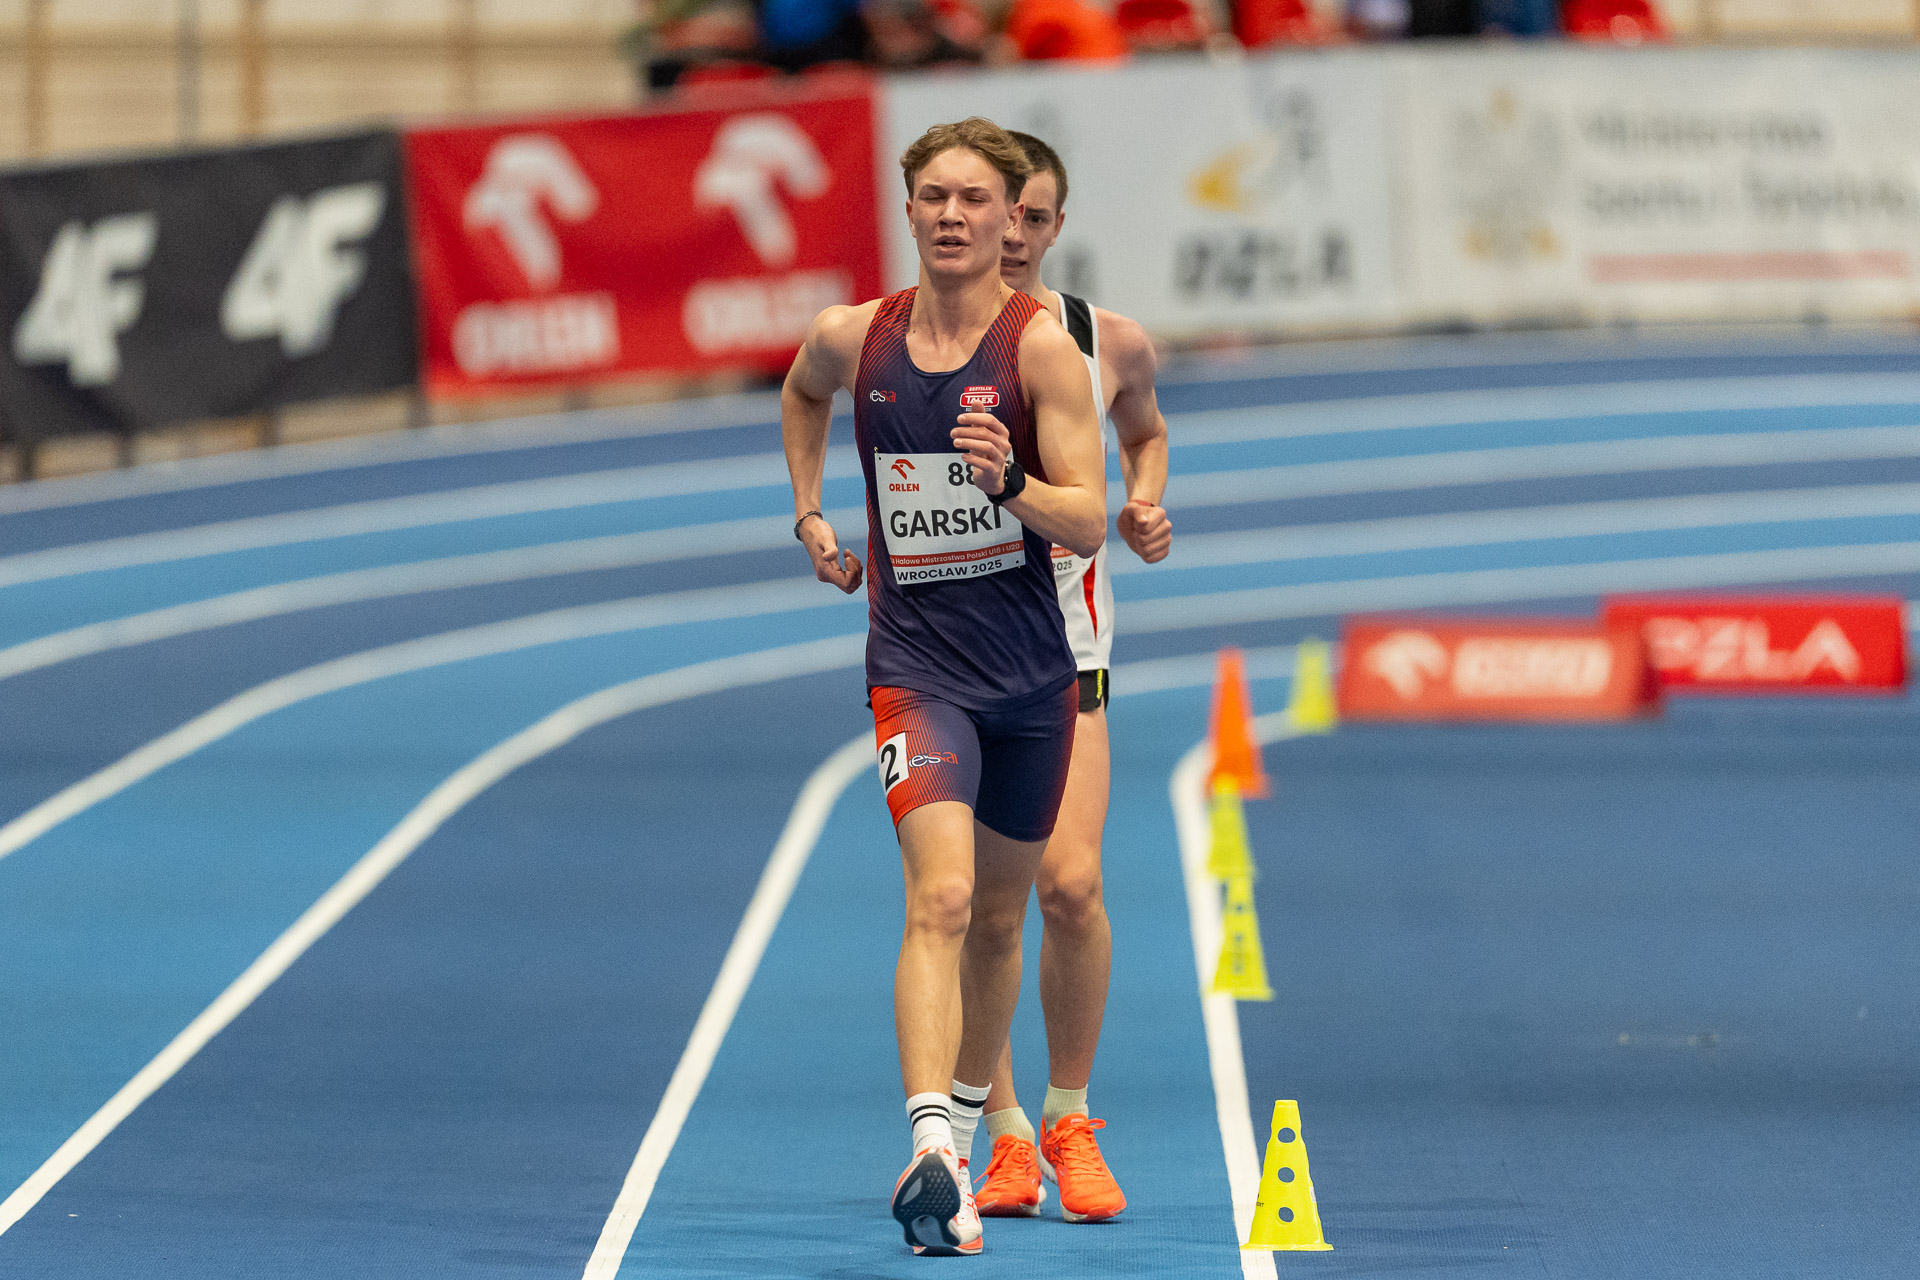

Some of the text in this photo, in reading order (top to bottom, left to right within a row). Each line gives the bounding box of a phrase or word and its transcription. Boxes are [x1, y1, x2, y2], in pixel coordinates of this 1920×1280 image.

[221, 183, 385, 355] 4F
[13, 211, 156, 386] 4F
[889, 483, 919, 492] ORLEN
[890, 504, 1002, 538] GARSKI
[895, 557, 920, 565] Halowe
[921, 554, 966, 564] Mistrzostwa
[966, 551, 988, 560] Polski
[988, 546, 1001, 555] U18
[1006, 543, 1020, 551] U20
[897, 559, 1003, 581] WROCŁAW 2025
[1645, 617, 1858, 681] PZLA
[881, 743, 900, 792] 2
